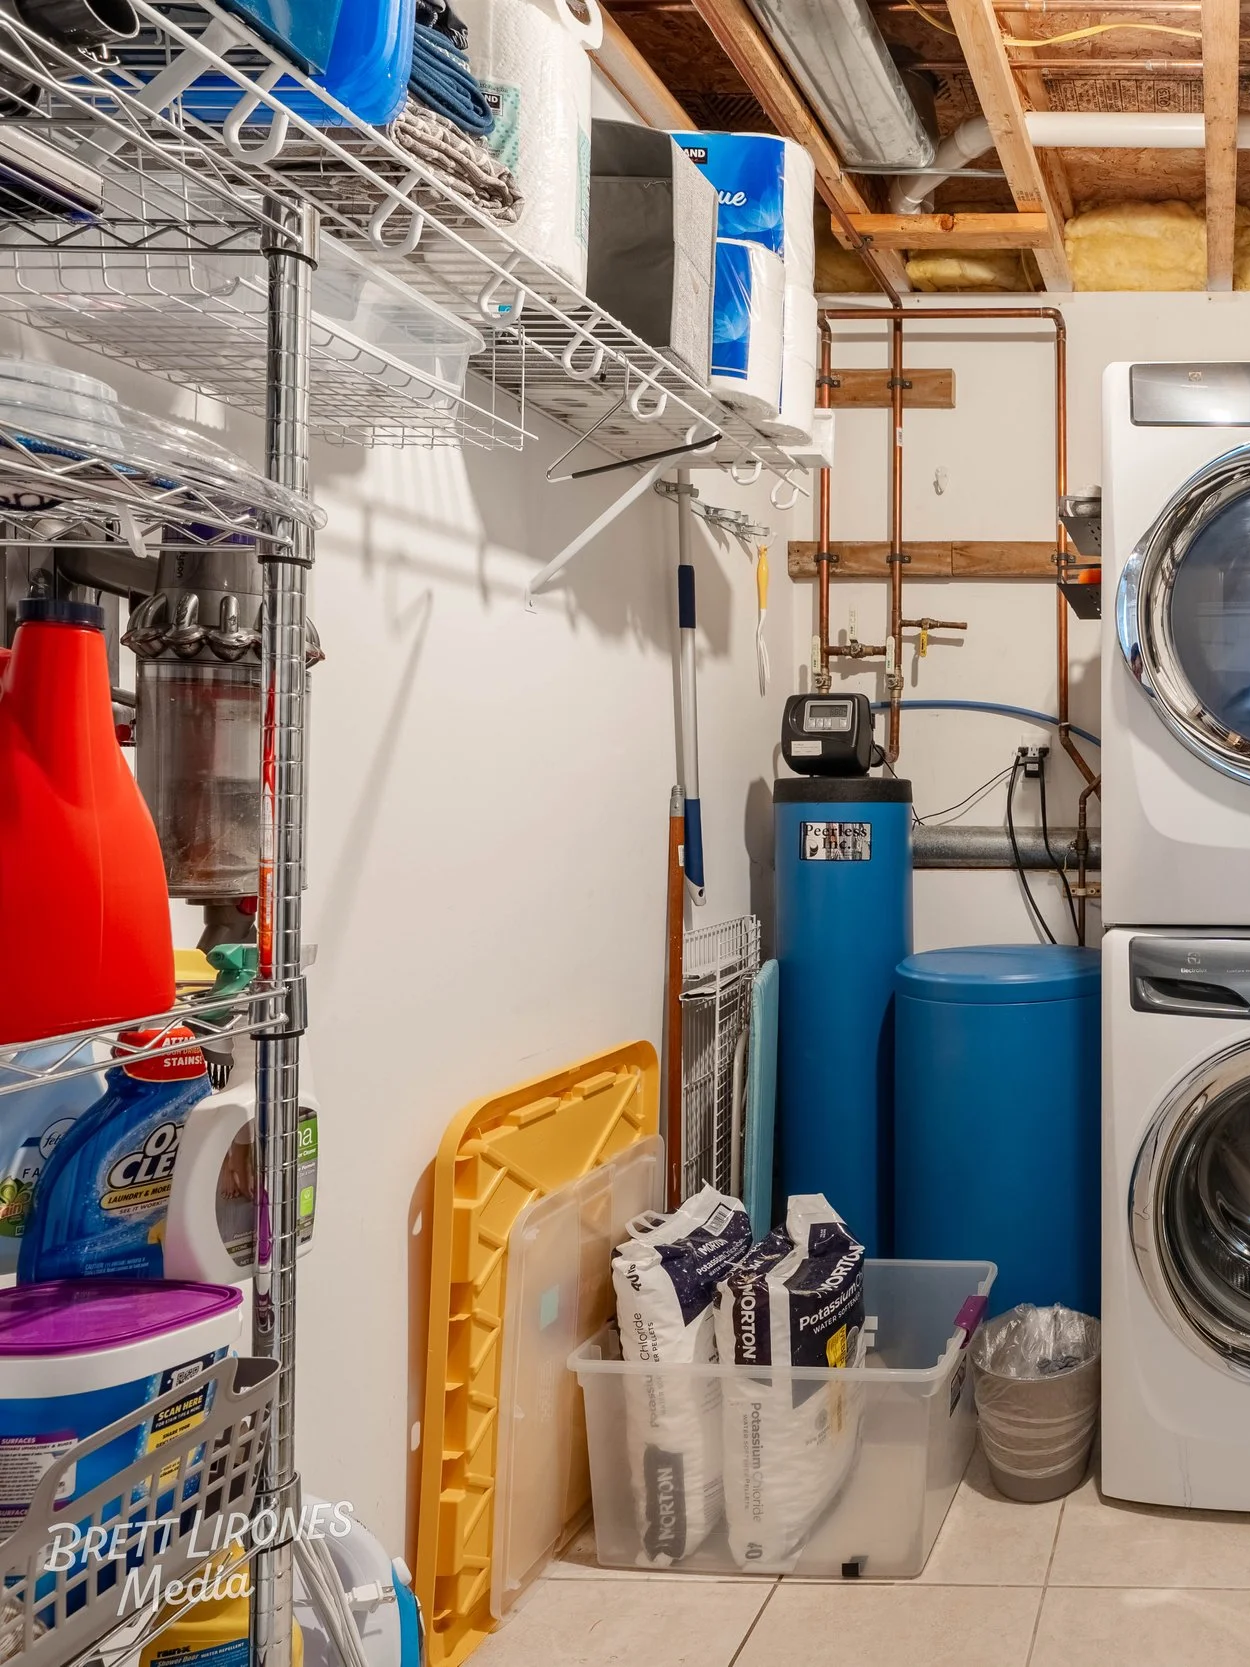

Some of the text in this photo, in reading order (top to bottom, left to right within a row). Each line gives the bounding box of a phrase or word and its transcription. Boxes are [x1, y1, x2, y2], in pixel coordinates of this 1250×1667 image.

[804, 824, 868, 838] Peerless
[821, 839, 851, 850] Inc.
[164, 1055, 203, 1068] STAINS!
[107, 1190, 142, 1205] LAUNDRY
[143, 1190, 150, 1198] &
[799, 1281, 857, 1331] Potassium
[739, 1284, 757, 1360] MORTON
[813, 1314, 838, 1335] WATER
[634, 1312, 651, 1361] Chloride
[648, 1321, 660, 1352] PELLETS
[157, 1394, 204, 1422] SCAN HERE
[1, 1437, 36, 1446] SURFACES
[751, 1402, 764, 1470] Potassium
[657, 1467, 676, 1541] MORTON
[218, 1642, 245, 1655] REPELLENT
